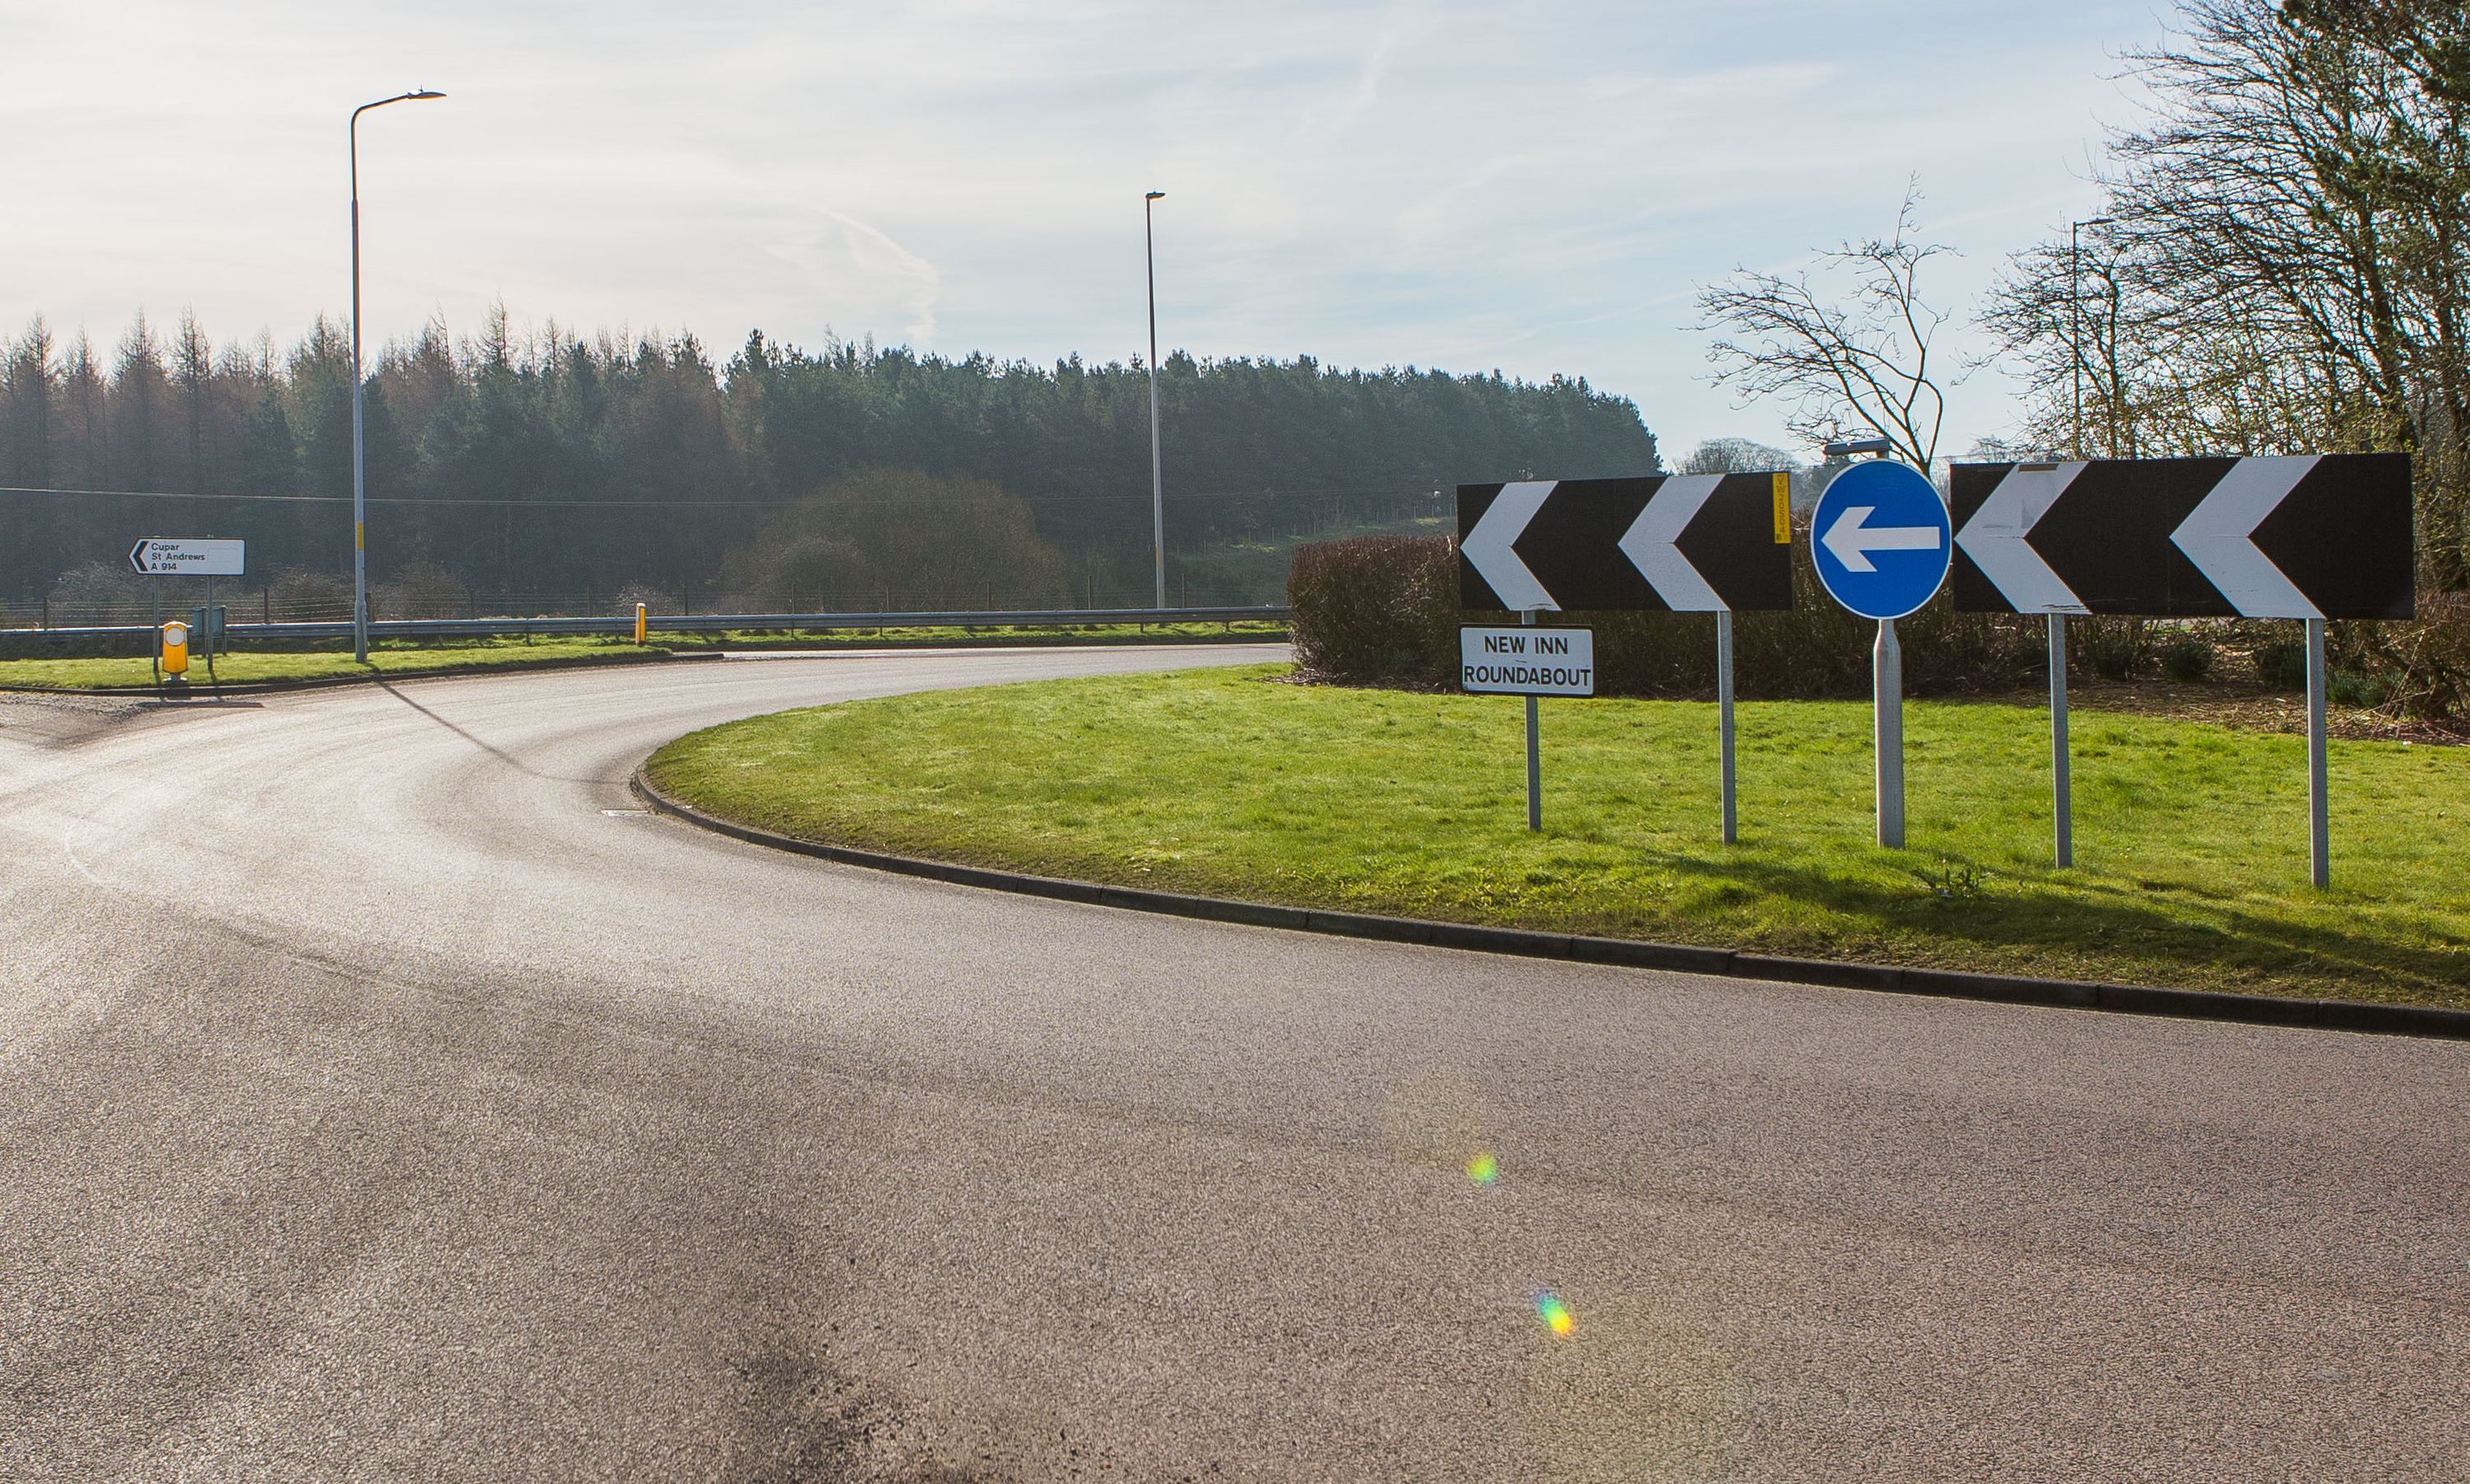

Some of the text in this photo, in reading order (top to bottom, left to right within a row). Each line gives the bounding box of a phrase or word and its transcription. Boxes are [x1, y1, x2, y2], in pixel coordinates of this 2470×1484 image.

[152, 543, 180, 551] Cupar
[1484, 636, 1568, 654] NEW INN
[1464, 665, 1591, 686] ROUNDABOUT
